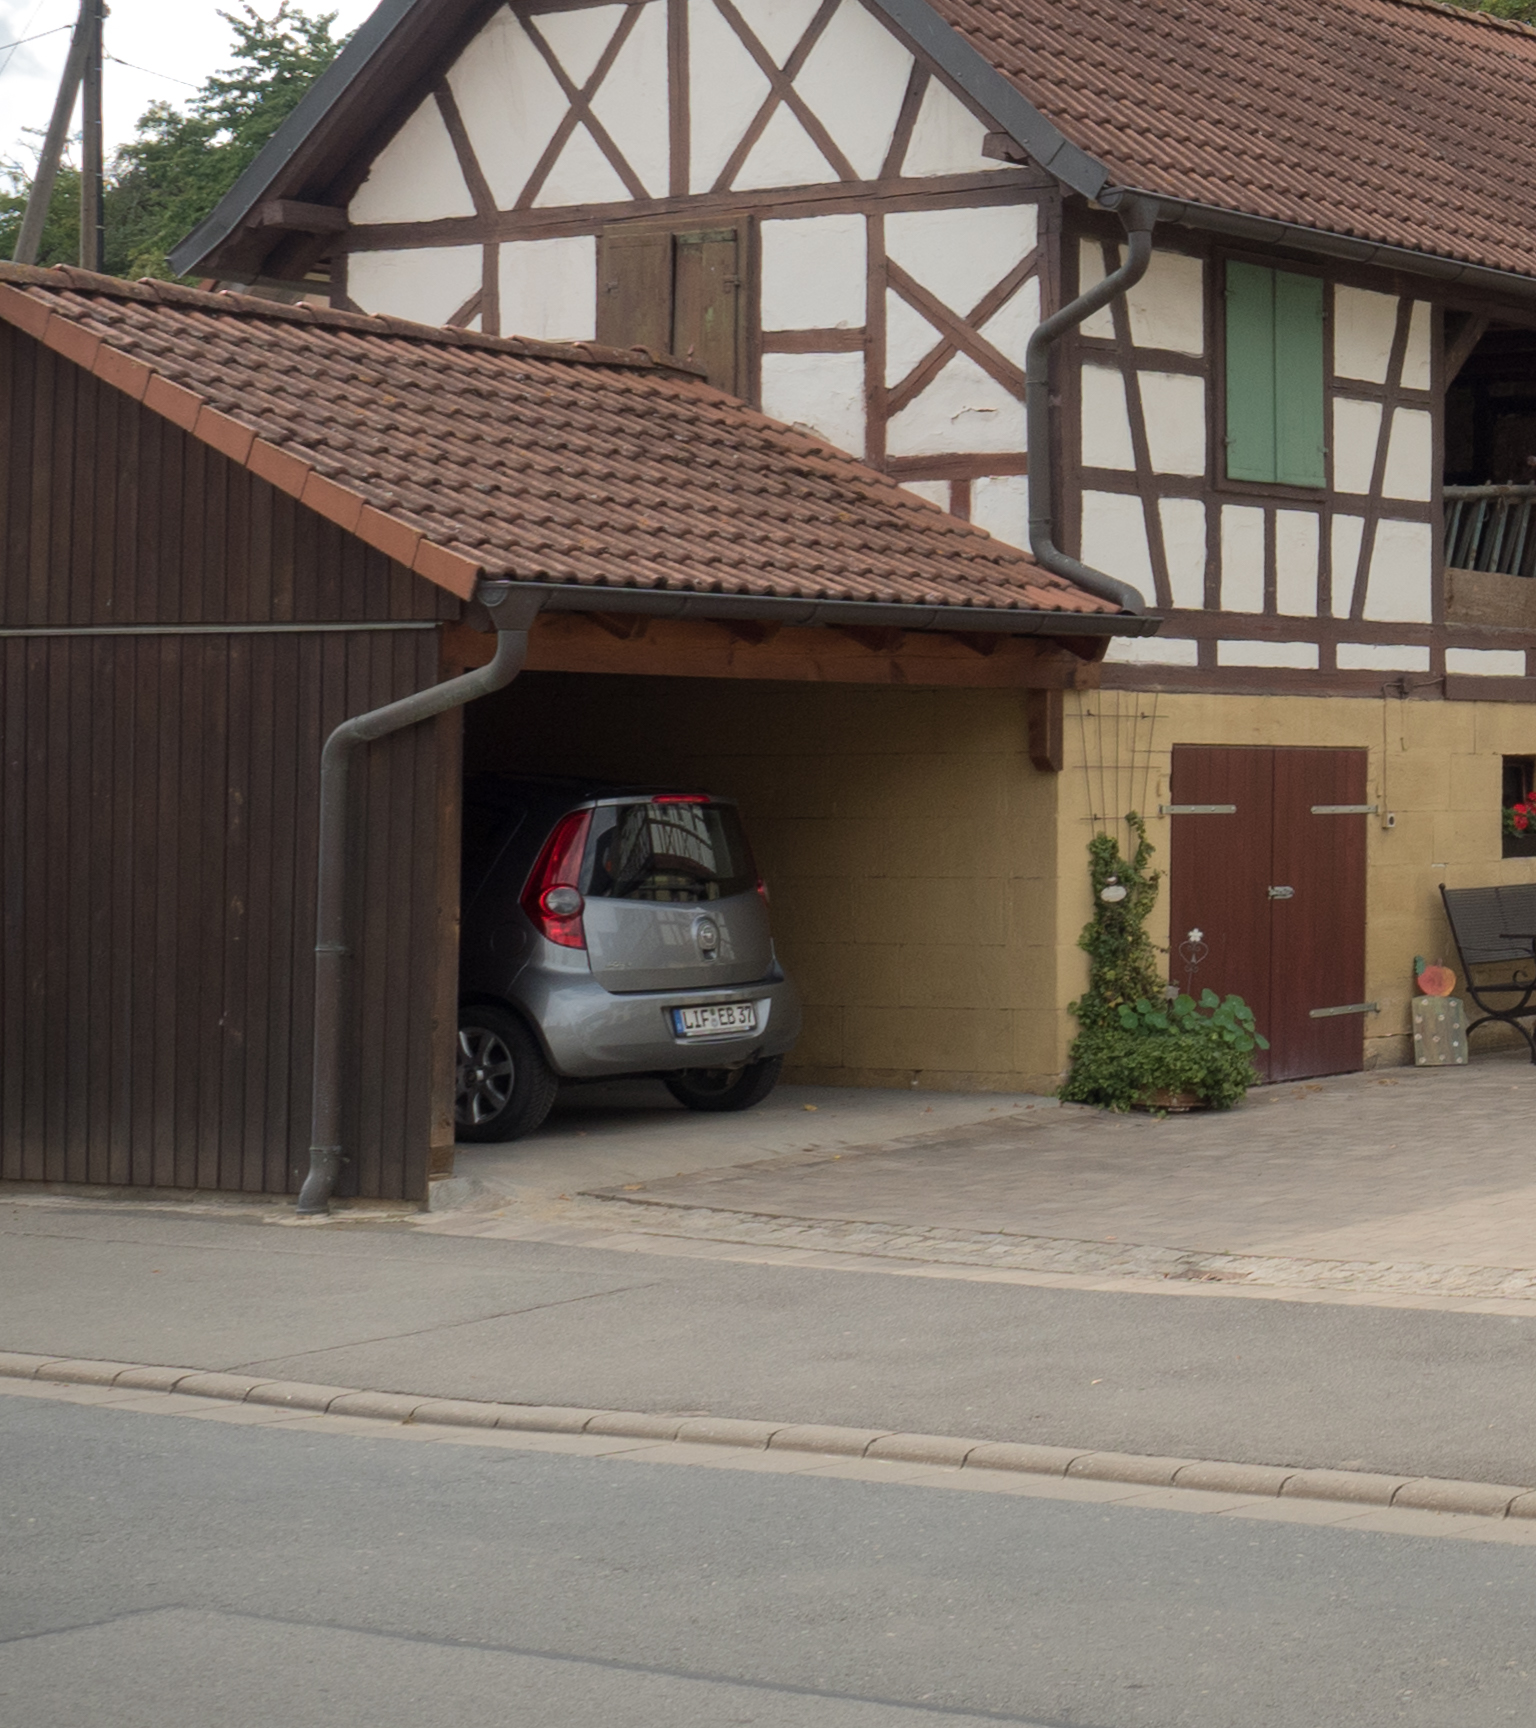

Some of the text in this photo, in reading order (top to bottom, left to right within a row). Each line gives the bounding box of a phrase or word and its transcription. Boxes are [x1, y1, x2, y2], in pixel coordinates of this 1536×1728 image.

[682, 1005, 752, 1029] LIF EB 37
